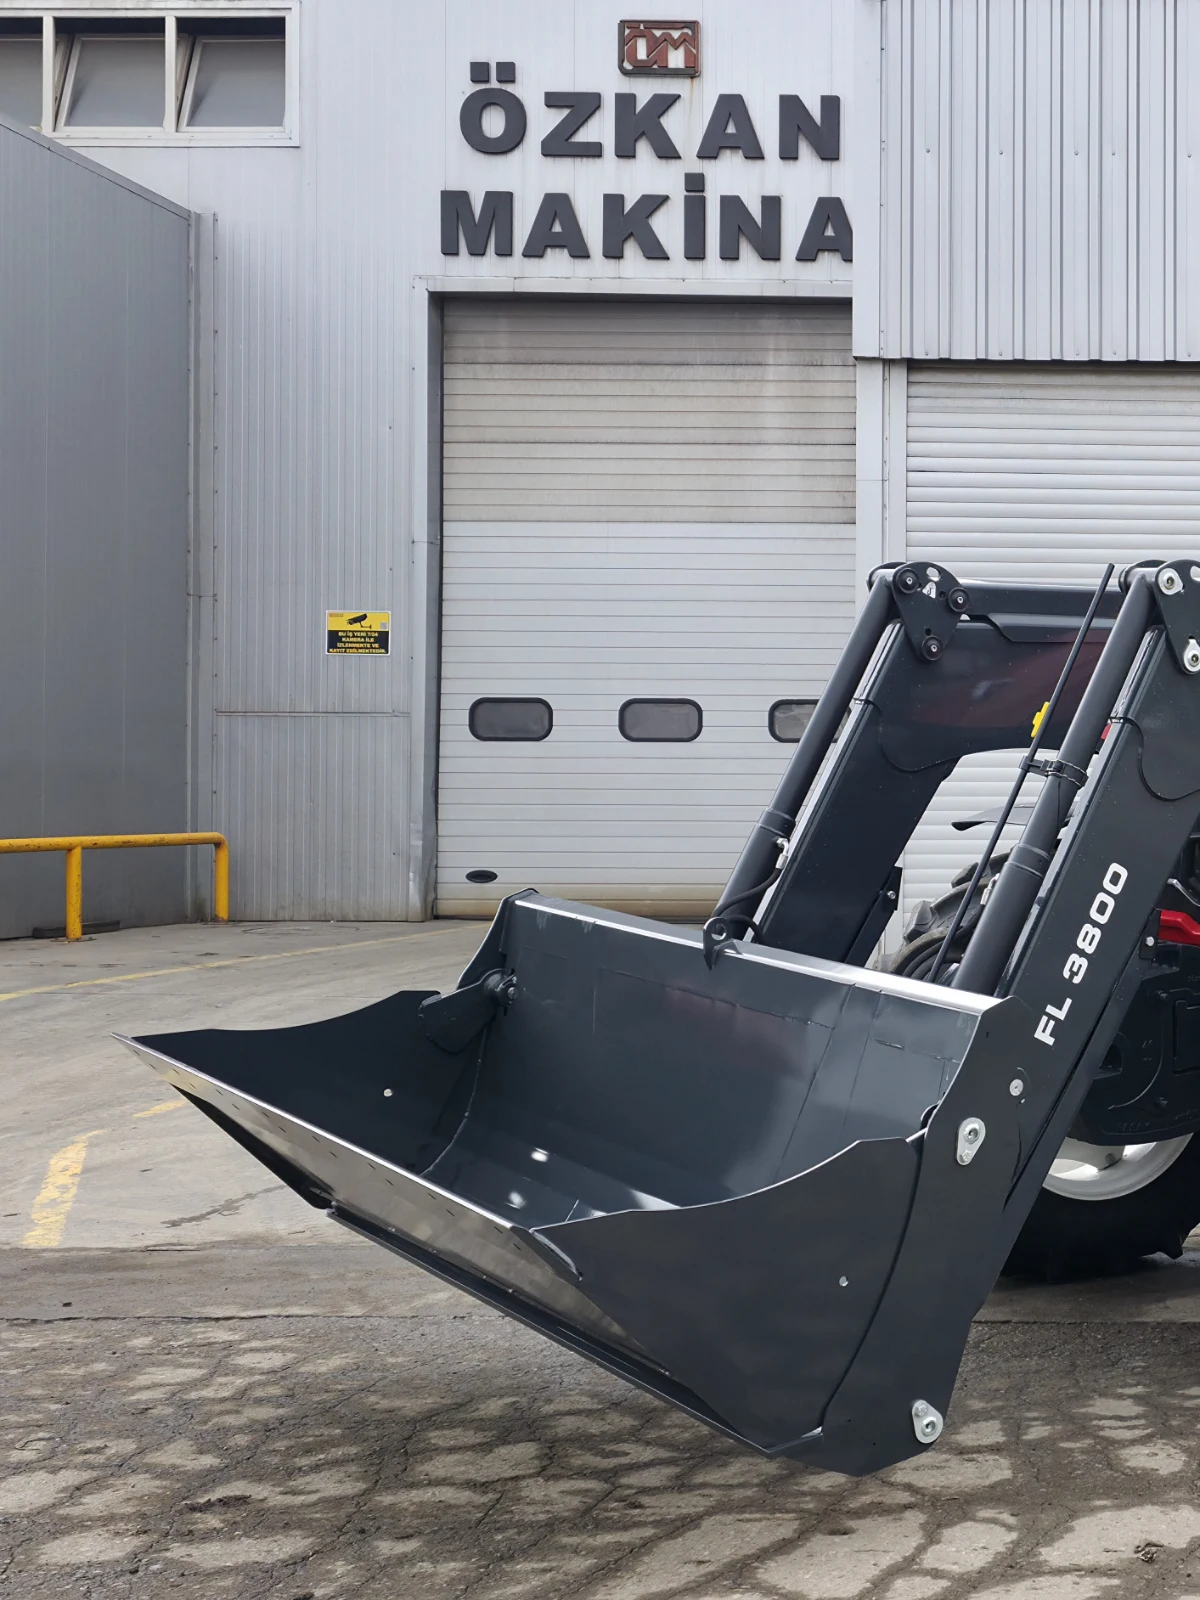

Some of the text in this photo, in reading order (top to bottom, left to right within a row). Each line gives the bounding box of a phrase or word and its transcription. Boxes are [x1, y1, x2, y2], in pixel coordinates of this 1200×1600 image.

[459, 61, 841, 160] ÖZKAN
[440, 172, 853, 262] MAKİNA
[1034, 863, 1128, 1046] FL 3800
